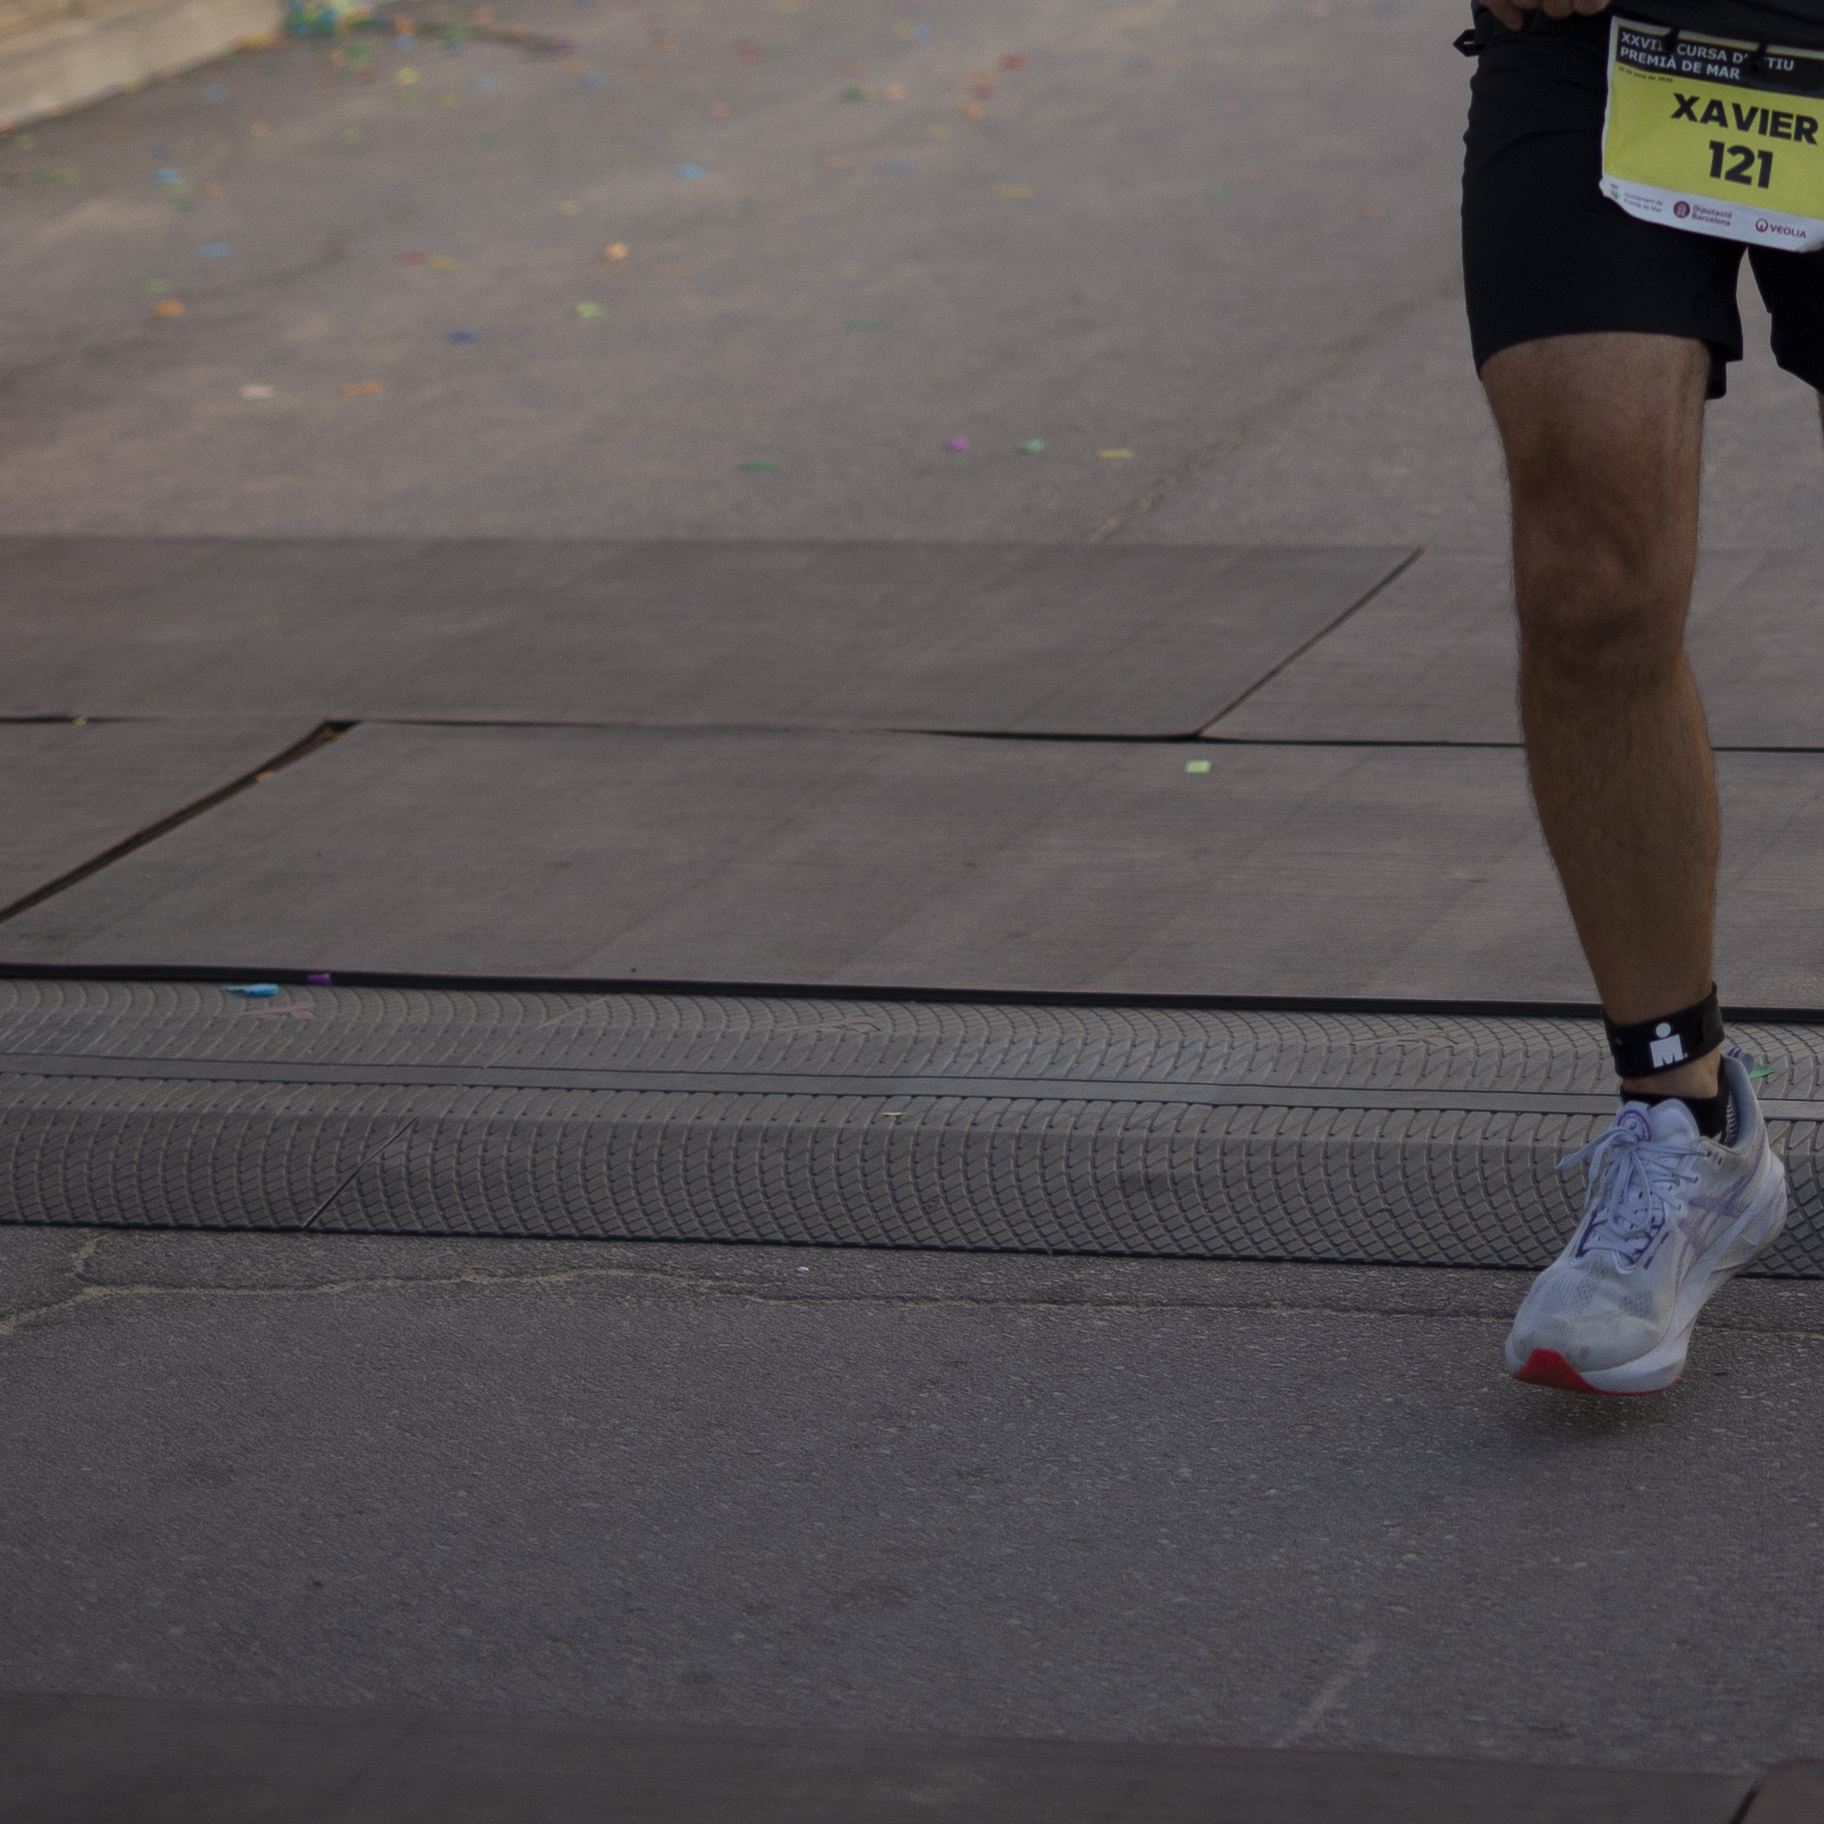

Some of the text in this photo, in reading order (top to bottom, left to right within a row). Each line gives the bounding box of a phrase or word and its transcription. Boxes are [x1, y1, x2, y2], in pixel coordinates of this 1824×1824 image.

[1620, 46, 1740, 80] PREMIÀ DE MAR
[1677, 42, 1727, 62] CURSA
[1732, 51, 1794, 71] D'TIU
[1670, 93, 1820, 146] XAVIER
[1709, 140, 1775, 190] 121
[1770, 223, 1807, 239] VEOLIA
